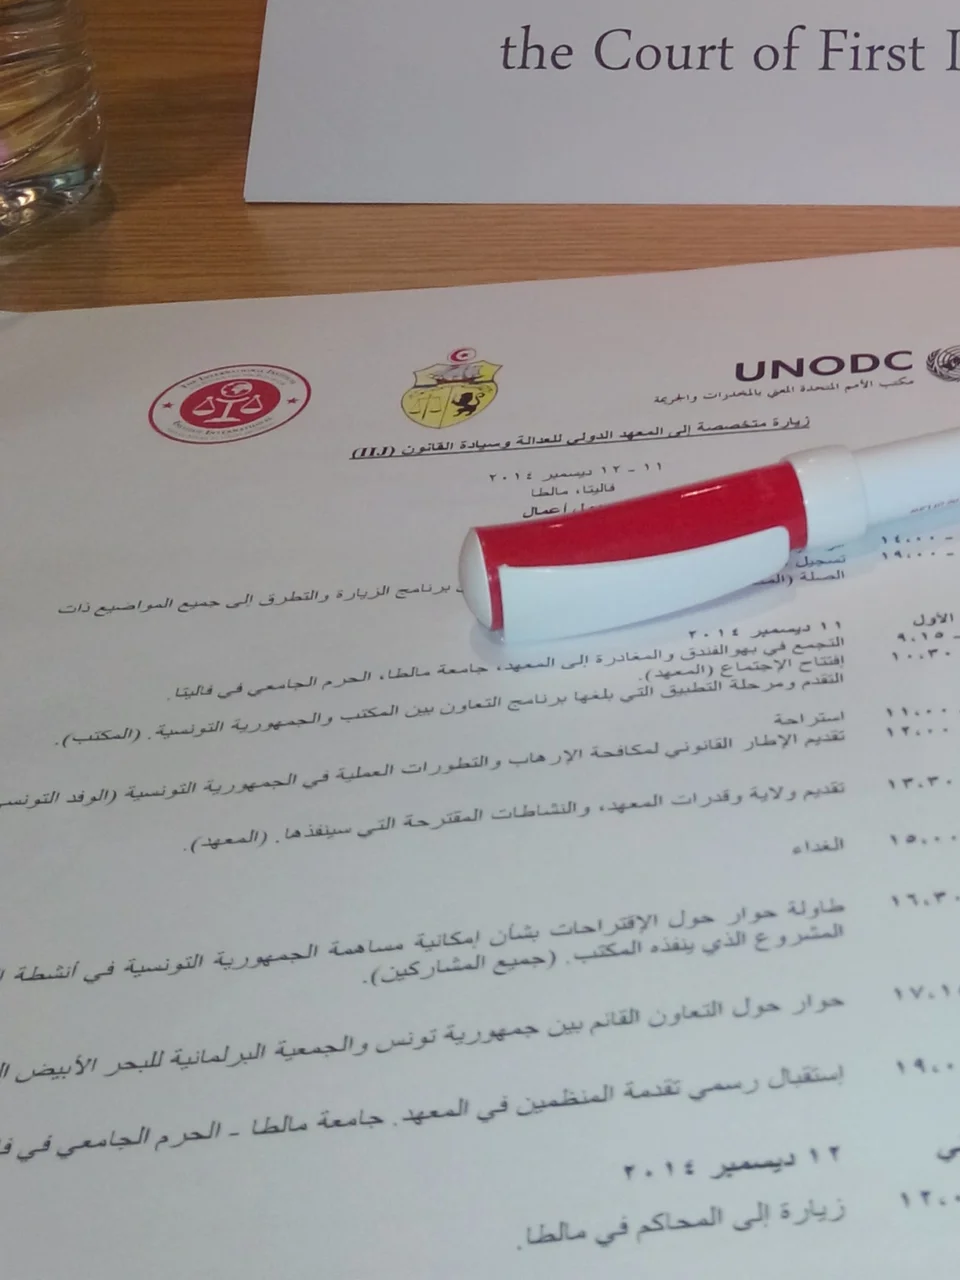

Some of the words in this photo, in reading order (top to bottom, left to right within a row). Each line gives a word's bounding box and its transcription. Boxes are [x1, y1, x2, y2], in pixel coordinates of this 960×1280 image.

[499, 23, 574, 71] the
[593, 27, 735, 72] Court
[752, 24, 807, 72] of
[817, 28, 926, 72] First
[735, 350, 913, 382] UNODC
[799, 381, 840, 393] المتحدة
[878, 375, 915, 390] مكتب
[702, 387, 763, 402] بالمخدرات
[668, 424, 691, 440] إلى
[697, 419, 767, 433] متخصصة
[773, 415, 811, 430] زيارة
[515, 433, 562, 446] للعدالة
[619, 426, 664, 441] المعهد
[401, 441, 454, 456] القانون
[460, 439, 511, 451] وسيادة
[540, 469, 593, 483] ديسمبر
[530, 485, 569, 498] مالطا
[800, 570, 845, 583] الصلة
[224, 592, 254, 610] إلى
[257, 589, 330, 607] والتطرق
[335, 584, 391, 602] الزيارة
[394, 583, 451, 600] برنامج
[57, 601, 91, 614] ذات
[93, 596, 174, 618] المواضيع
[176, 600, 221, 614] جميع
[912, 611, 955, 628] الأول
[749, 623, 812, 639] ديسمبر
[762, 640, 787, 658] في
[791, 635, 845, 656] التجمع
[560, 653, 589, 671] إلى
[595, 648, 675, 667] والمغادرة
[436, 662, 489, 676] جامعة
[638, 663, 715, 689] (المعهد).
[216, 682, 244, 700] في
[246, 675, 318, 698] الجامعي
[321, 670, 372, 691] الحرم
[659, 679, 723, 699] التطبيق
[728, 677, 797, 693] ومرحلة
[801, 671, 844, 691] التقدم
[506, 693, 568, 712] برنامج
[574, 687, 615, 705] بلغها
[619, 684, 654, 704] التي
[339, 703, 400, 724] المكتب
[404, 705, 435, 719] بين
[439, 695, 502, 716] التعاون
[230, 711, 334, 734] والجمهورية
[773, 710, 845, 728] استراحة
[54, 726, 142, 749] (المكتب).
[664, 736, 733, 760] القانوني
[743, 732, 798, 752] الإطار
[803, 729, 846, 749] تقديم
[508, 748, 583, 768] الإرهاب
[589, 741, 660, 759] لمكافحة
[334, 762, 395, 784] العملية
[400, 754, 502, 777] والتطورات
[123, 780, 198, 802] التونسية
[202, 772, 298, 796] الجمهورية
[301, 772, 330, 790] في
[802, 781, 846, 802] تقديم
[65, 787, 118, 807] (الوفد
[670, 788, 744, 809] وقدرات
[749, 785, 797, 803] ولاية
[402, 807, 484, 831] المقترحة
[490, 800, 591, 821] والنشاطات
[356, 815, 396, 839] التي
[183, 828, 269, 854] (المعهد).
[791, 835, 845, 856] الغداء
[727, 907, 779, 927] حوار
[786, 897, 846, 920] طاولة
[667, 909, 716, 930] حول
[413, 930, 481, 953] إمكانية
[488, 923, 540, 948] بشأن
[701, 930, 747, 957] الذي
[753, 922, 845, 953] المشروع
[212, 942, 319, 971] الجمهورية
[327, 939, 404, 957] مساهمة
[649, 937, 696, 956] ينفذه
[13, 960, 81, 983] أنشطة
[82, 960, 115, 985] في
[123, 952, 205, 979] التونسية
[362, 953, 486, 987] المشاركين).
[492, 949, 557, 977] (جميع
[647, 999, 724, 1029] التعاون
[731, 996, 782, 1020] حول
[791, 993, 846, 1016] حوار
[442, 1023, 541, 1046] جمهورية
[547, 1019, 585, 1038] بين
[273, 1034, 369, 1063] والجمعية
[375, 1028, 438, 1055] تونس
[103, 1049, 166, 1078] للبحر
[169, 1041, 267, 1071] البرلمانية
[13, 1053, 99, 1085] الأبيض
[515, 1083, 615, 1117] المنظمين
[687, 1079, 760, 1103] رسمي
[315, 1108, 385, 1130] جامعة
[475, 1095, 509, 1124] في
[251, 1113, 309, 1136] مالطا
[55, 1125, 152, 1161] الجامعي
[153, 1119, 222, 1152] الحرم
[15, 1134, 53, 1164] في
[709, 1152, 797, 1181] ديسمبر
[731, 1200, 771, 1233] إلى
[779, 1198, 846, 1226] زيارة
[594, 1215, 630, 1249] في
[635, 1205, 724, 1244] المحاكم
